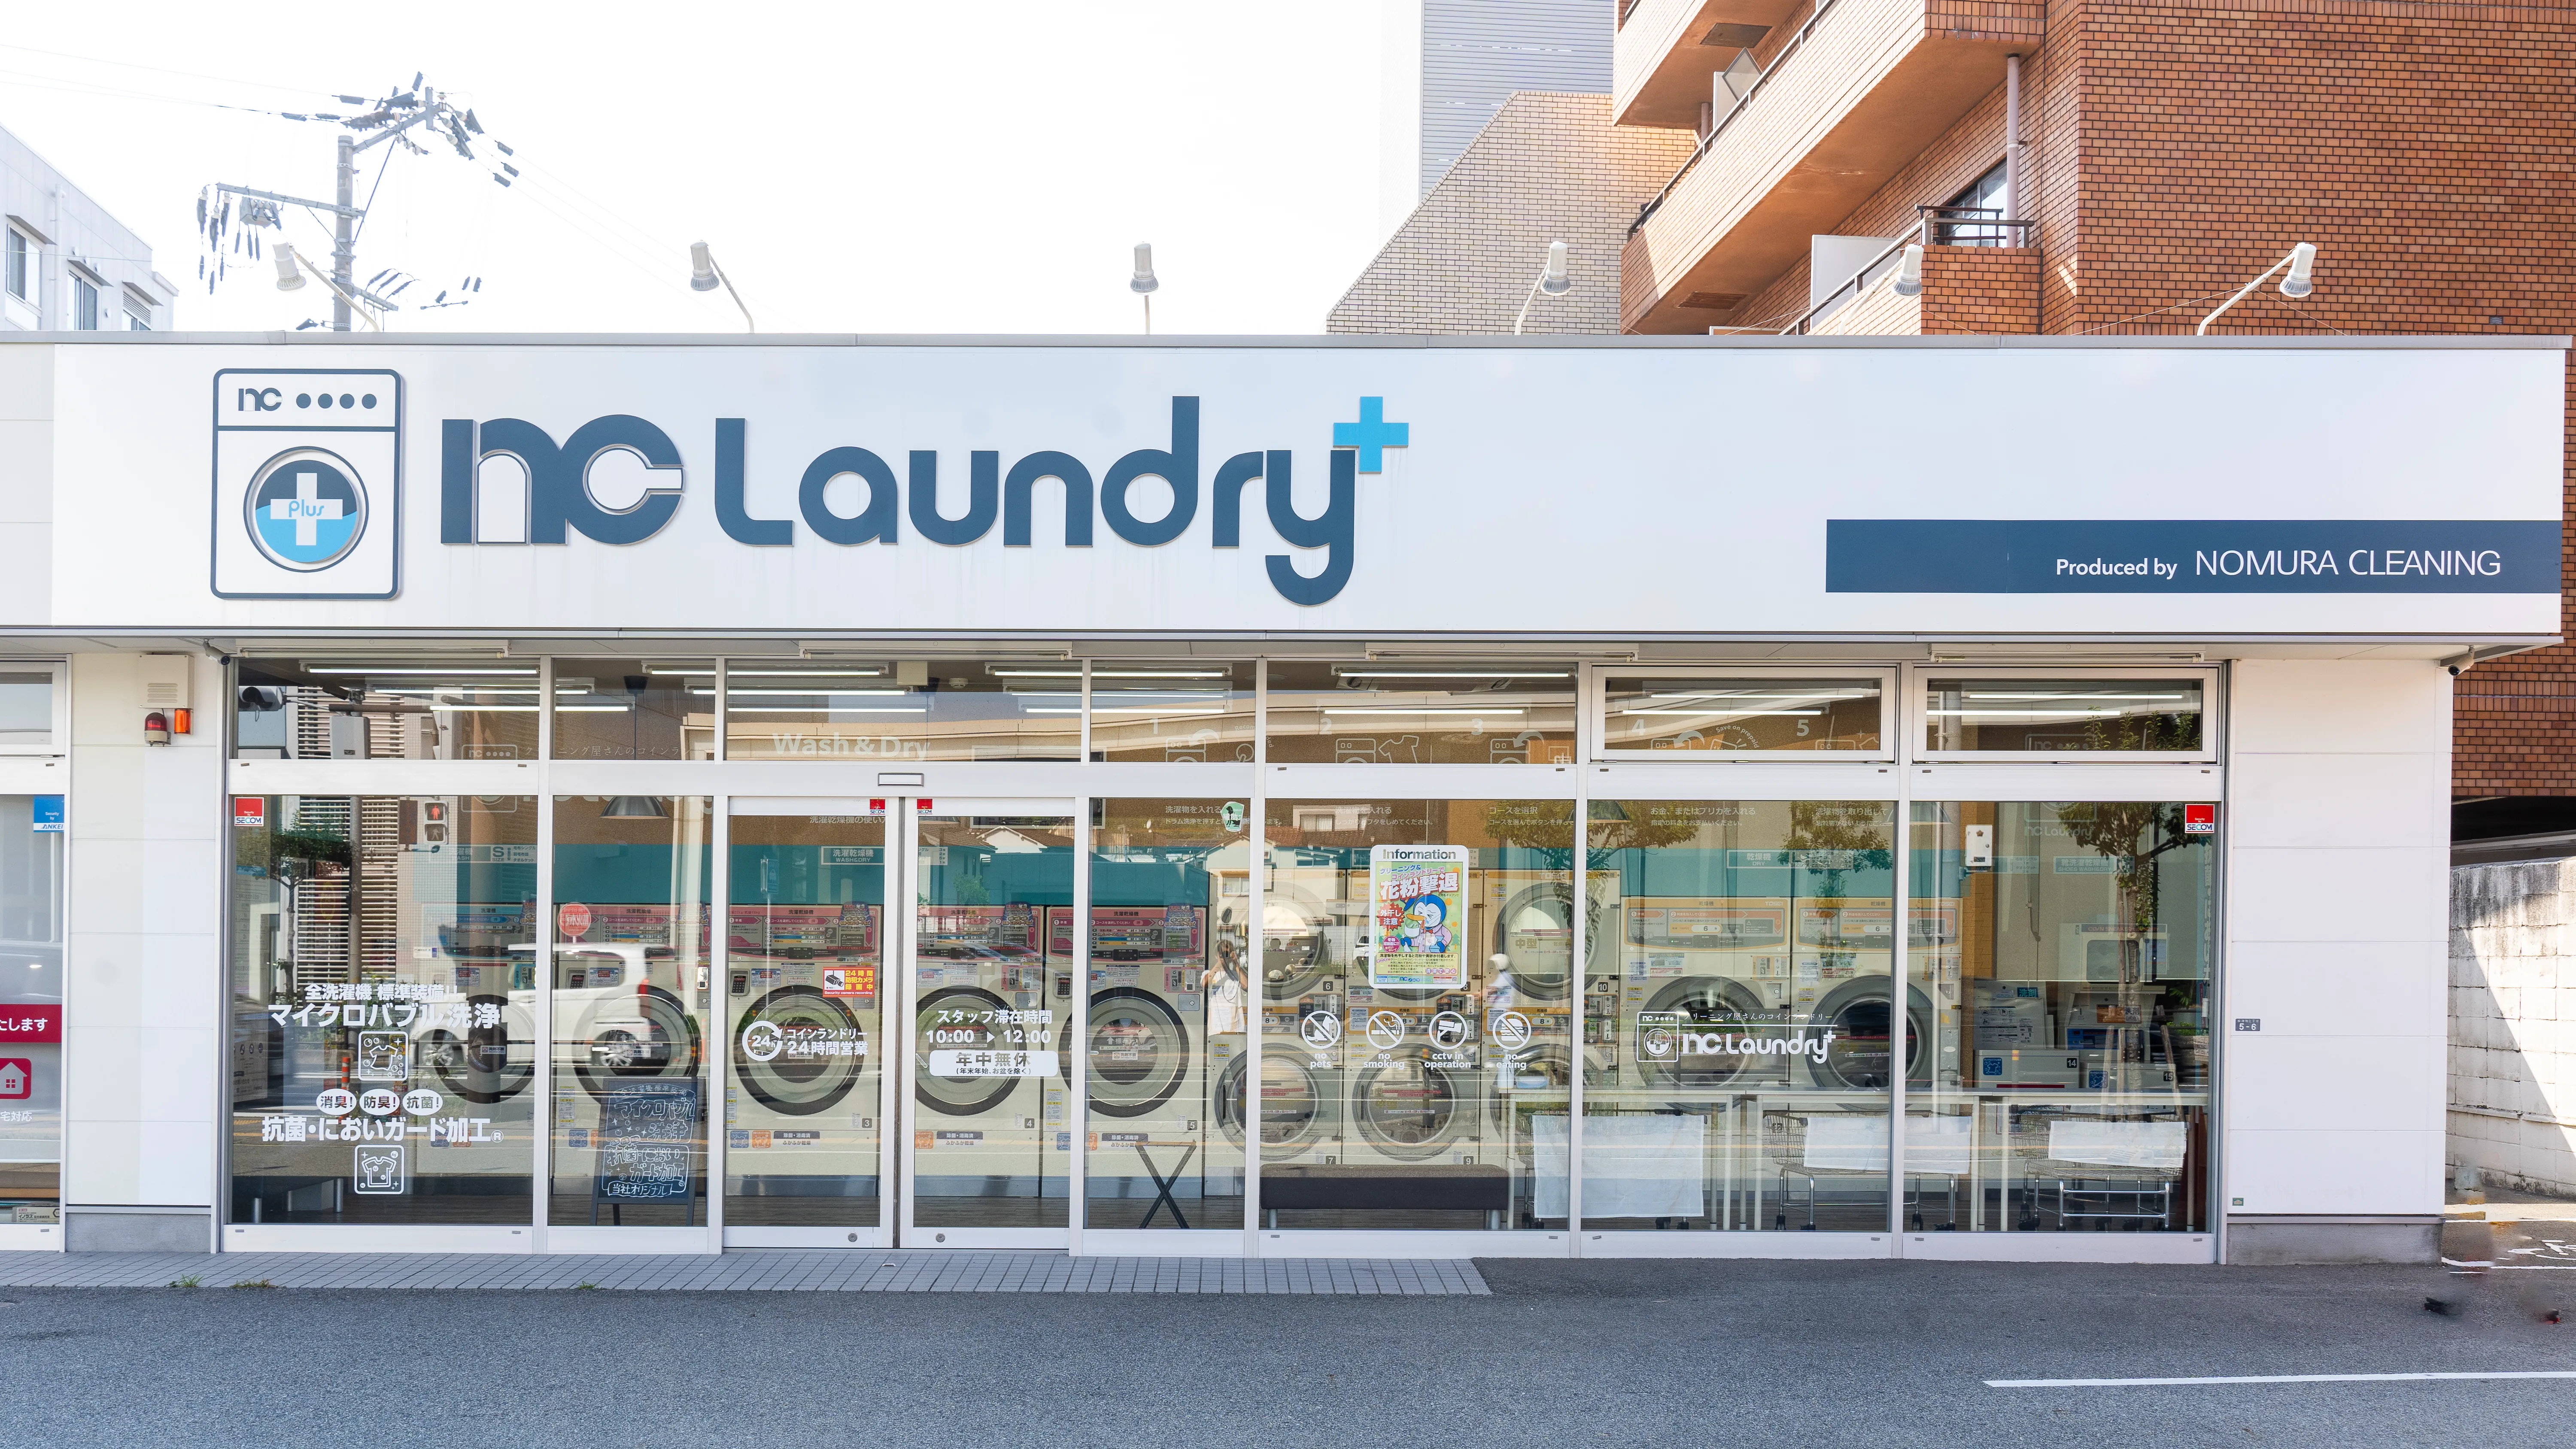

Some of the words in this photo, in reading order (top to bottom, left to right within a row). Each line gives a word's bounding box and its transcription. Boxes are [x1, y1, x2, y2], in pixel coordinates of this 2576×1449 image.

[441, 414, 684, 546] nc
[288, 498, 325, 519] Plus
[2056, 558, 2148, 576] Produced
[2152, 558, 2178, 580] by
[2196, 550, 2339, 576] NOMURA
[2348, 550, 2502, 576] CLEANING
[1149, 718, 1159, 734] 1
[1320, 718, 1333, 735] 2
[1471, 718, 1483, 735] 3
[1632, 719, 1646, 736] 4
[1796, 719, 1809, 737] 5
[1715, 724, 1732, 733] Save
[1740, 728, 1760, 749] prepaid
[773, 733, 851, 755] Wash
[854, 737, 870, 755] &
[879, 736, 930, 761] Dry
[1165, 805, 1221, 814] 洗濯物を入れる
[1335, 806, 1392, 815] 洗濯物を入れる
[1489, 806, 1538, 815] コースを選択
[1650, 807, 1756, 816] お金、またはプリカを入れる
[492, 846, 504, 858] S
[832, 849, 875, 858] 洗濯乾燥機
[1383, 849, 1456, 860] Information
[1746, 853, 1771, 861] 乾燥機
[1391, 867, 1445, 880] コインランドリーで
[1380, 872, 1458, 900] 花粉撃退
[1515, 938, 1537, 949] 中型
[304, 983, 372, 1000] 全洗濯機
[2019, 988, 2037, 997] 洗剤
[267, 1003, 501, 1029] マイクロバブル洗浄
[936, 1009, 1052, 1025] スタッフ滞在時間
[2124, 1006, 2139, 1015] 洗剤
[787, 1028, 868, 1039] コインランドリー
[926, 1030, 975, 1043] 10:00
[1003, 1030, 1051, 1043] 12:00
[787, 1040, 869, 1056] 24時間営業
[1683, 1033, 1722, 1055] nc
[955, 1052, 1031, 1067] 年中無休
[1452, 1052, 1464, 1060] in
[1310, 1061, 1331, 1070] pets
[1363, 1060, 1405, 1070] smoking
[1425, 1060, 1471, 1070] operation
[1496, 1061, 1527, 1070] eating
[320, 1095, 353, 1109] 消臭!
[364, 1095, 396, 1109] 防臭!
[407, 1095, 440, 1109] 抗菌!
[614, 1097, 695, 1121] マイクロバブル
[647, 1119, 688, 1142] 洗浄
[612, 1183, 668, 1196] 当社オリジナル
